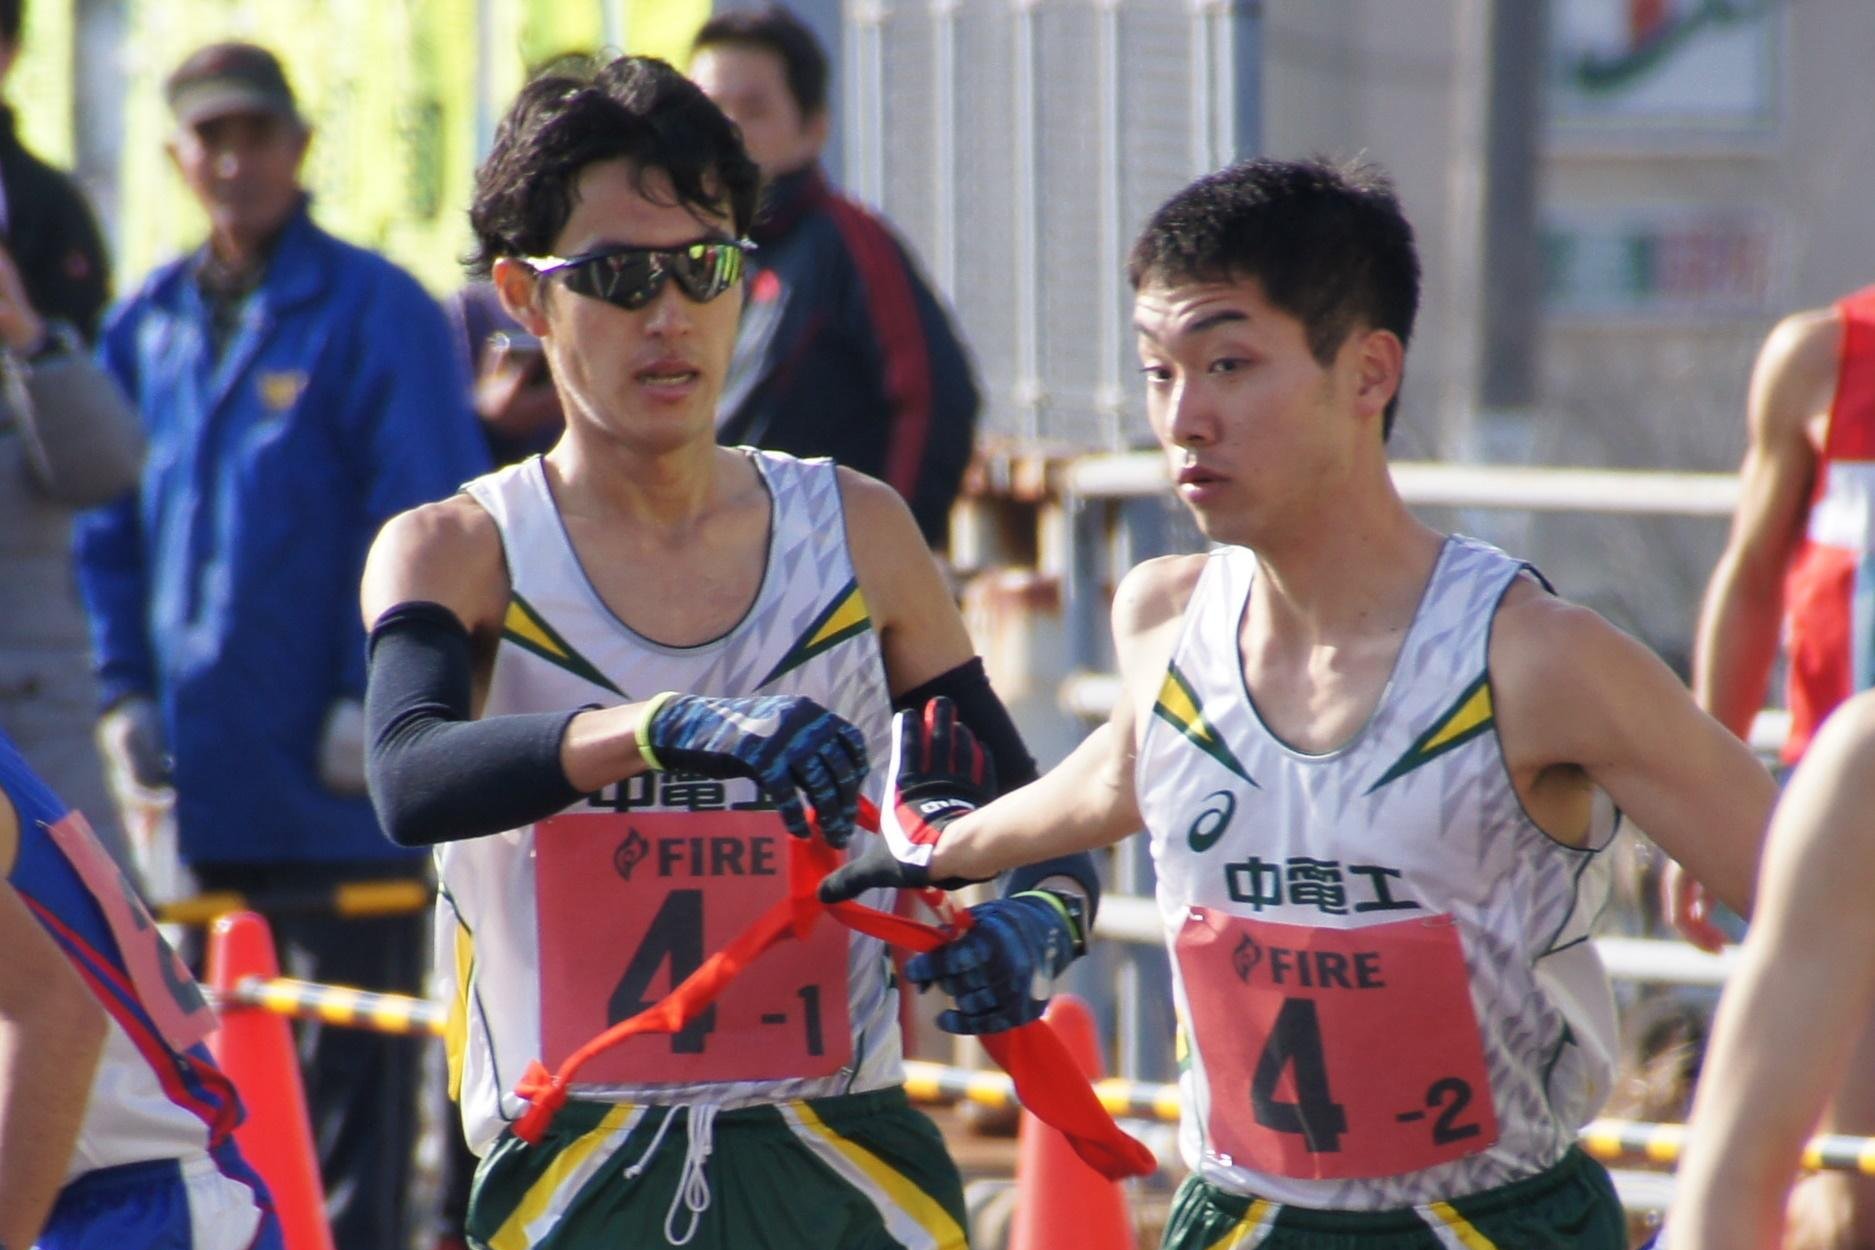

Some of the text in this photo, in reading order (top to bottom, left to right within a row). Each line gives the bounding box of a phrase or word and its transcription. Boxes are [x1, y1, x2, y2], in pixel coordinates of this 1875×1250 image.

[657, 837, 777, 878] FIRE
[1225, 856, 1421, 914] 中電工
[1271, 949, 1386, 989] FIRE
